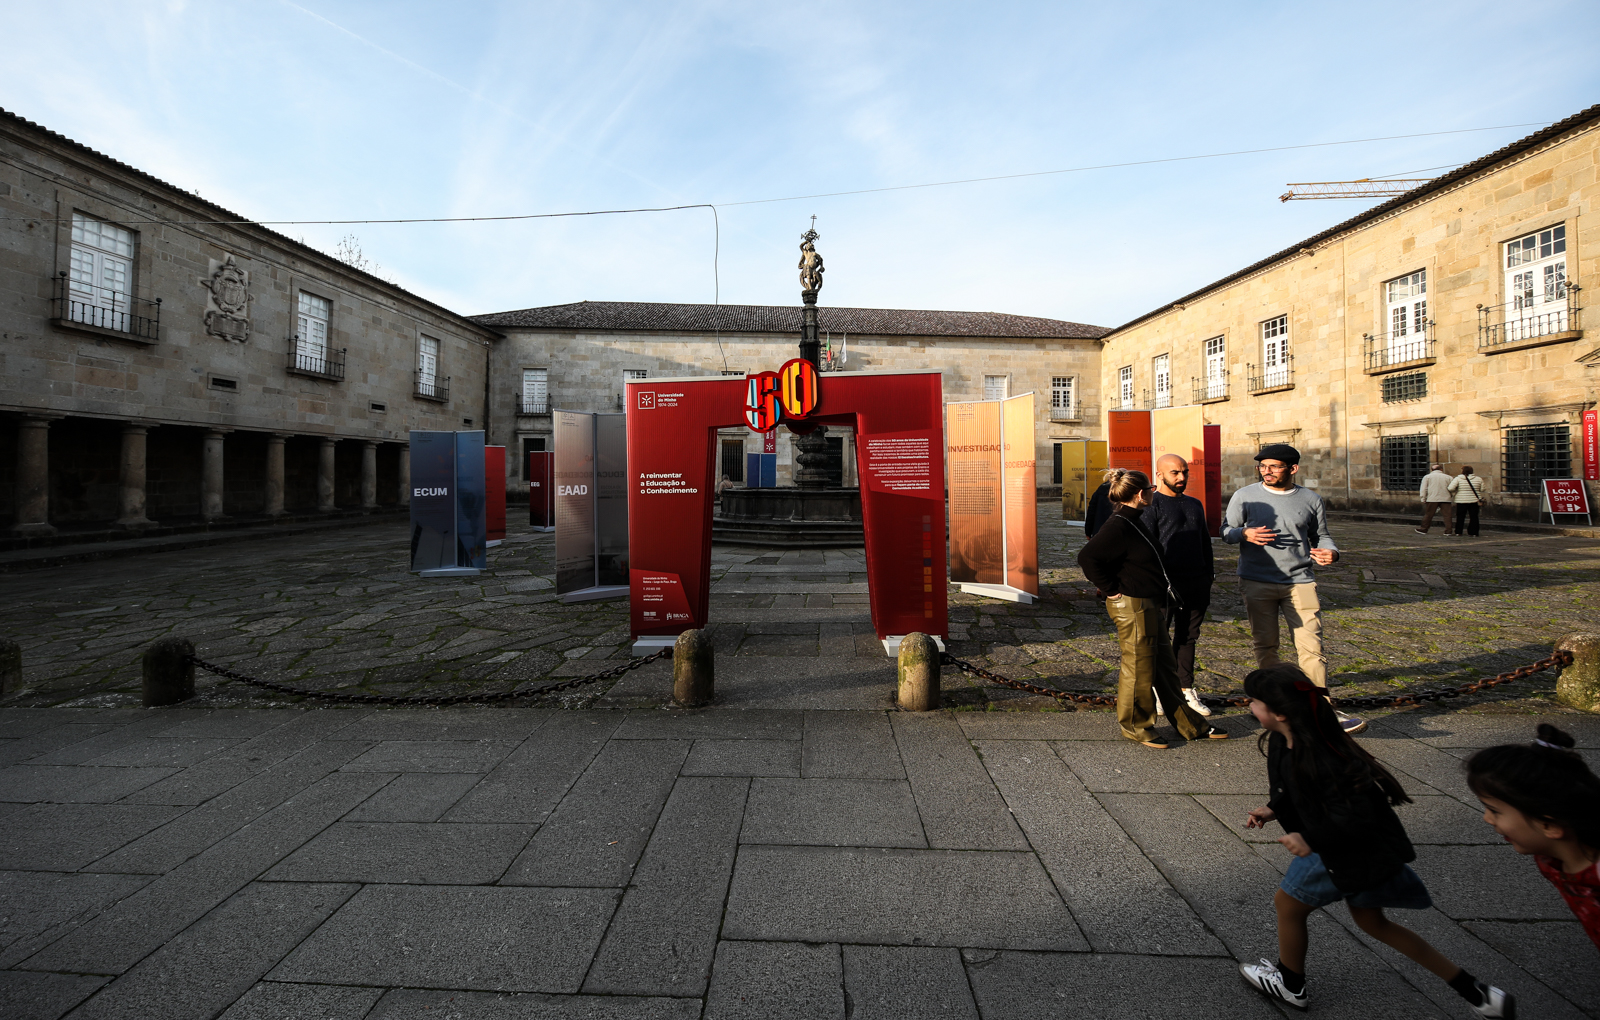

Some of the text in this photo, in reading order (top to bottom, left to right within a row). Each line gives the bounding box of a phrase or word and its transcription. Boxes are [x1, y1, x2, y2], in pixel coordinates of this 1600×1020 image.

[744, 359, 818, 432] 50
[414, 487, 448, 497] ECUM
[558, 485, 588, 496] EAAD
